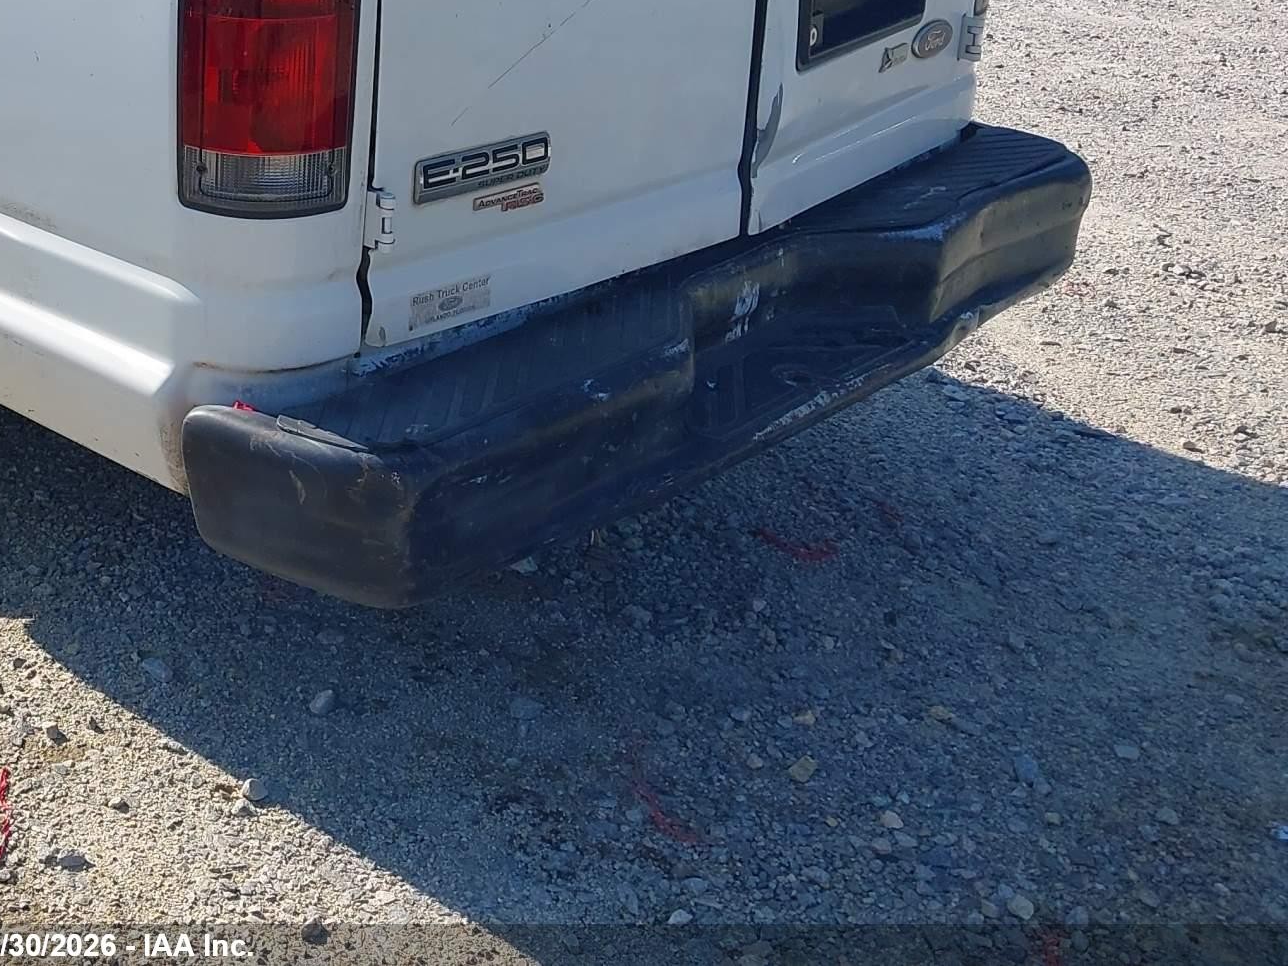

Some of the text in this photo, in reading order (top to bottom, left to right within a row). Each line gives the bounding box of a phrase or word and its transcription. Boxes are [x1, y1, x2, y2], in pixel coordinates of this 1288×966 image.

[422, 136, 550, 190] E-250
[412, 293, 434, 307] Rush
[437, 284, 460, 299] Truck
[462, 277, 490, 292] Center
